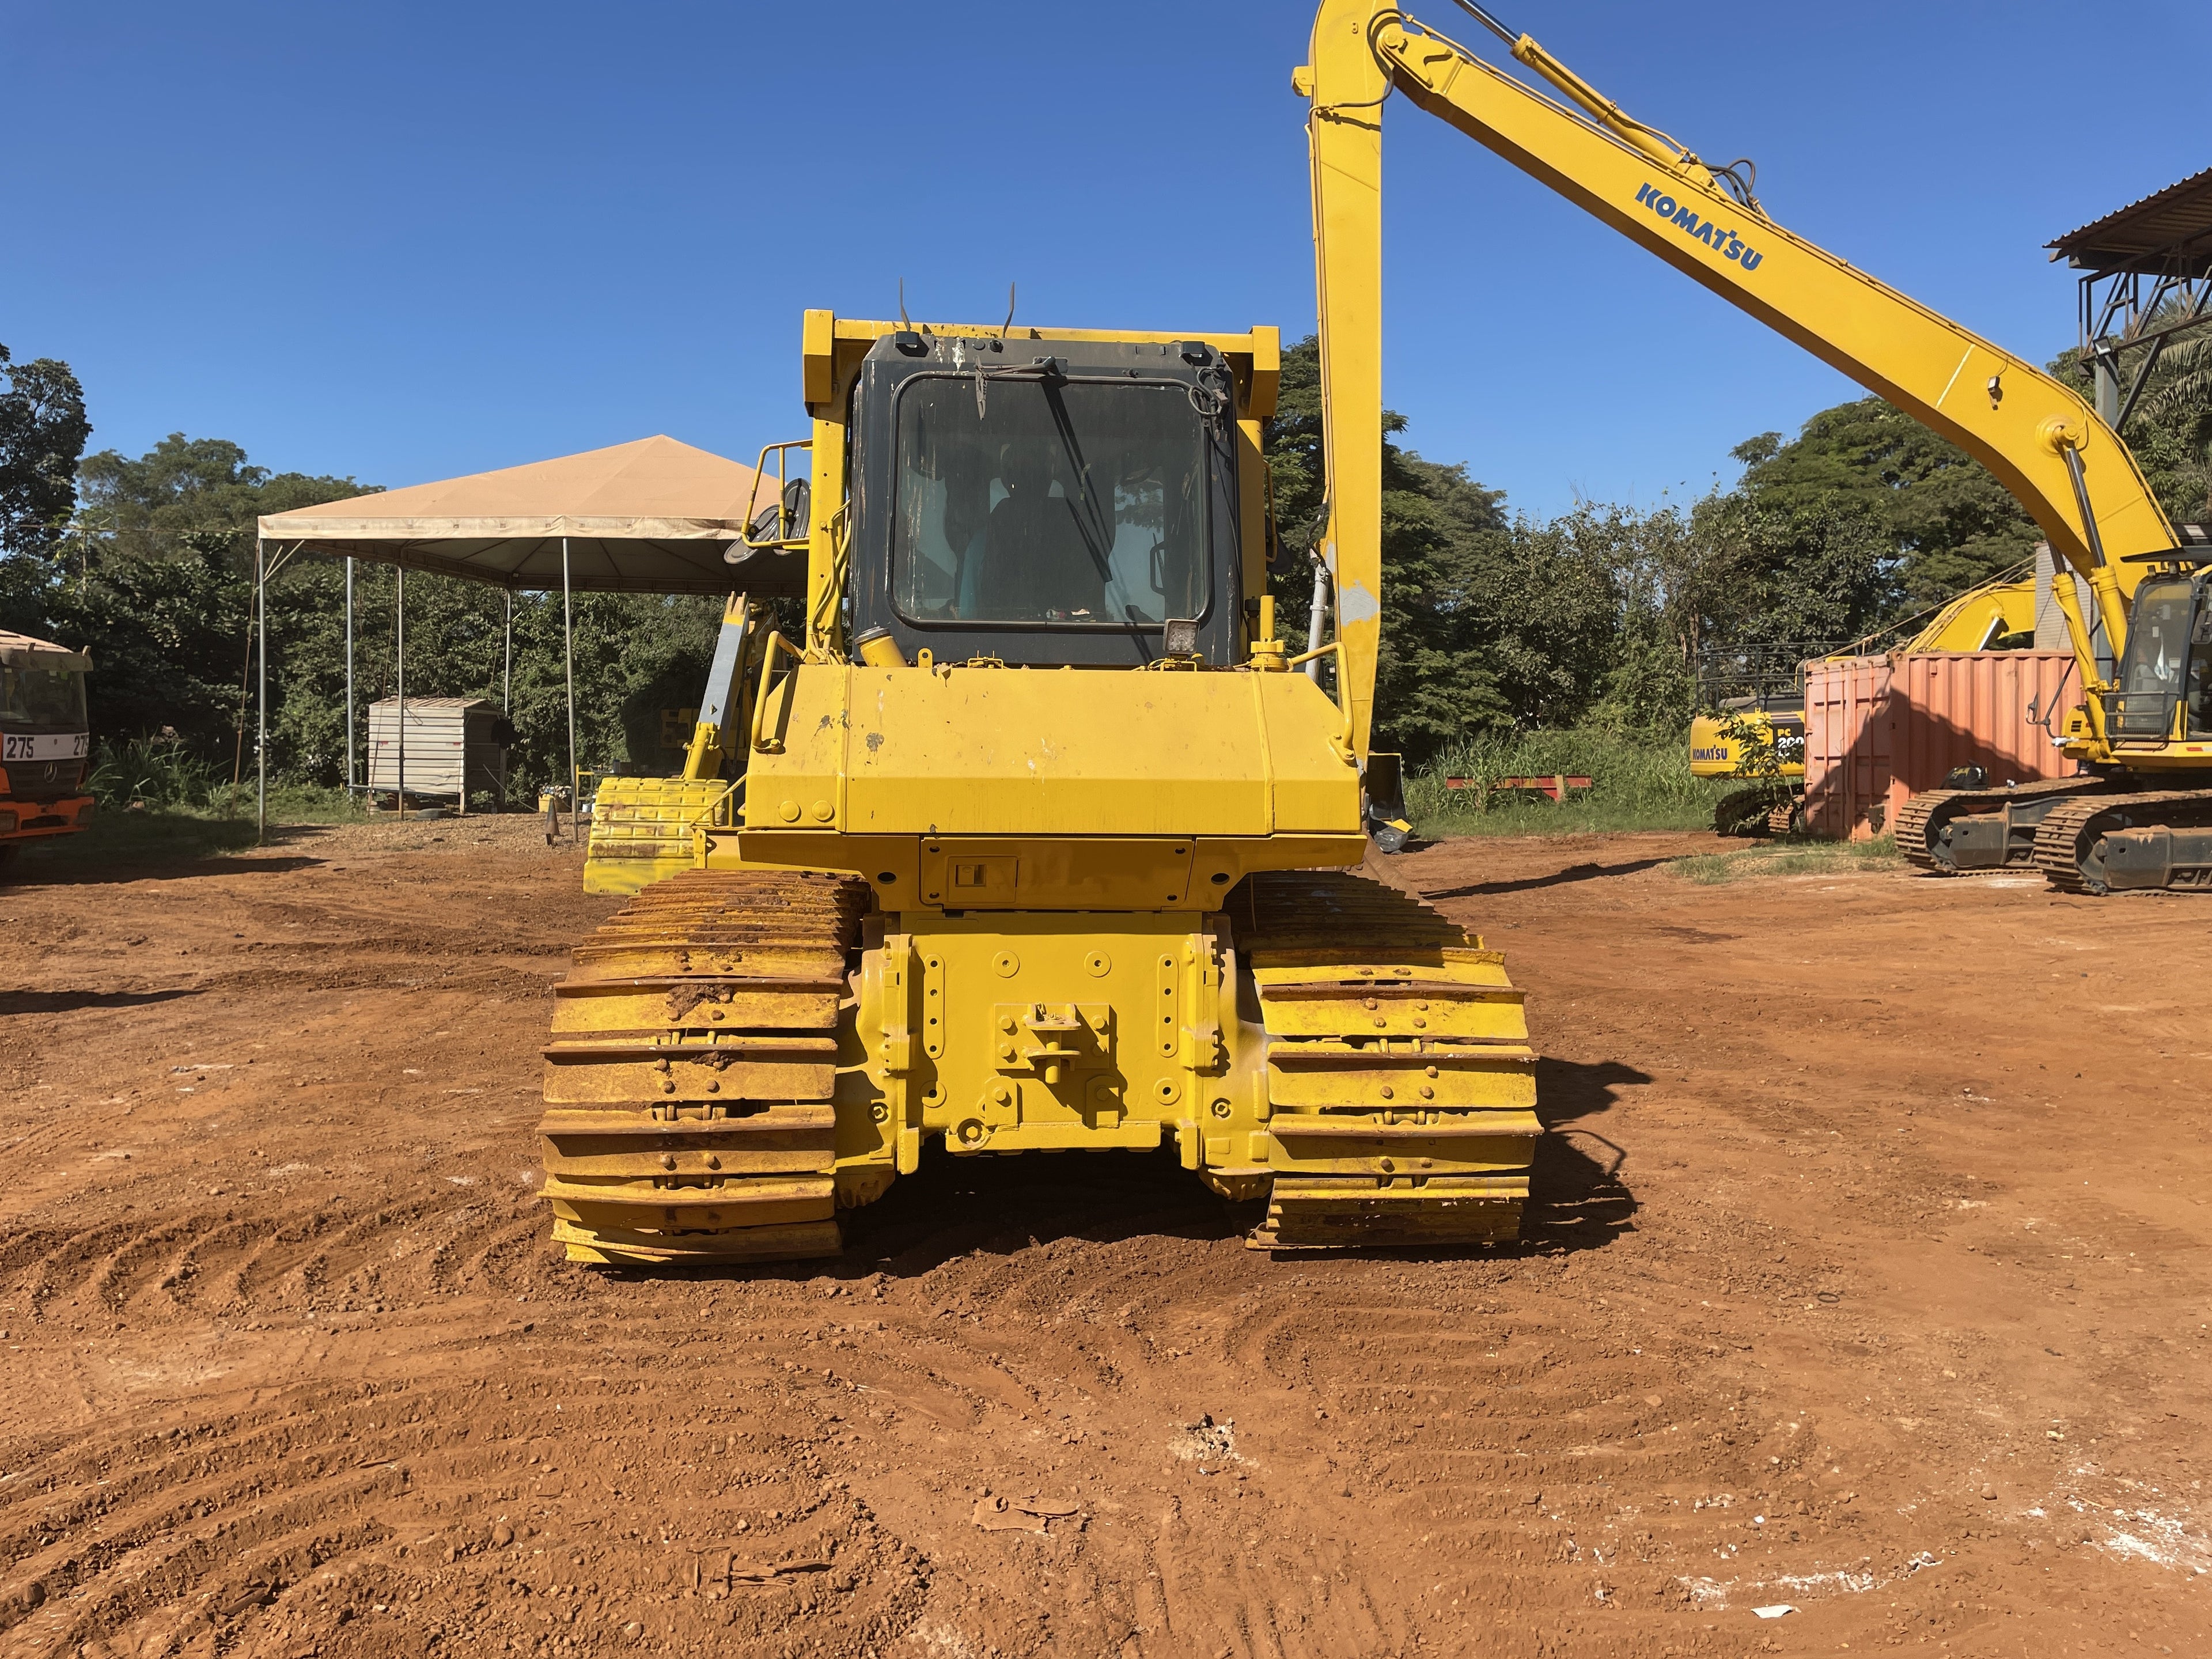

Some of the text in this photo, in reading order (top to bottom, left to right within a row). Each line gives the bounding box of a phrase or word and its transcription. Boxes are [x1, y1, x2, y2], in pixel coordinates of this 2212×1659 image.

[1634, 181, 1764, 271] KOMATSU
[1777, 728, 1791, 737] PC
[6, 736, 35, 759] 275
[1692, 744, 1728, 761] KOMATSU
